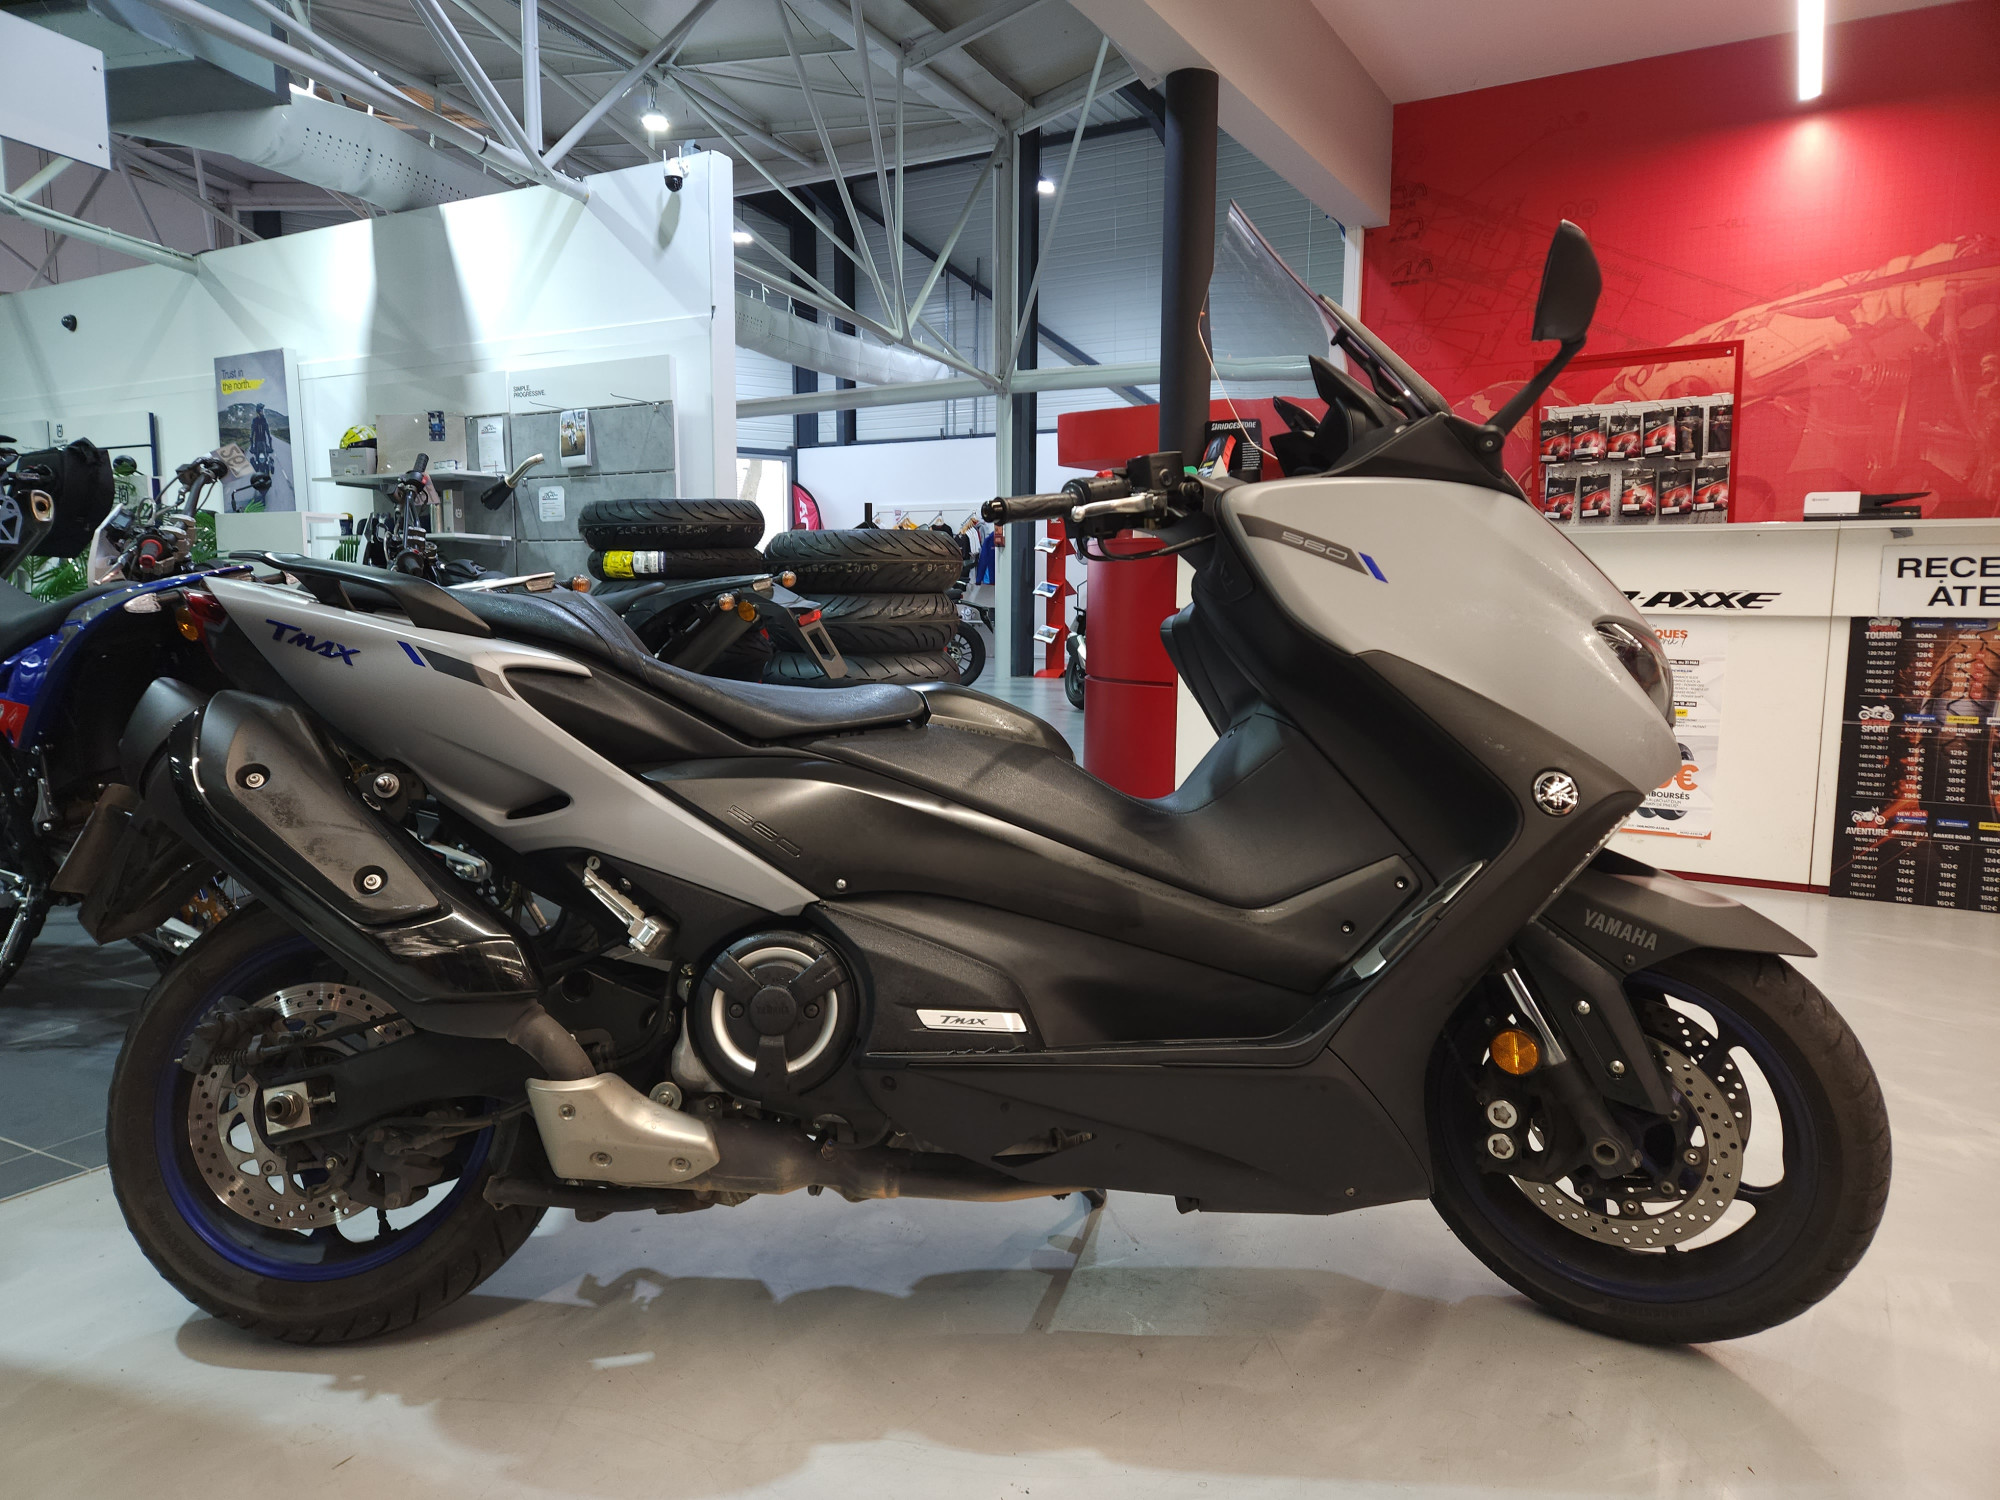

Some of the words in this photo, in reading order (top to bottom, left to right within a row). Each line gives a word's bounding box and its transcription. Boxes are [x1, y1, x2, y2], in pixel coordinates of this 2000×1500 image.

[222, 370, 236, 379] Trust
[238, 368, 244, 377] in
[222, 383, 232, 391] the
[1282, 530, 1348, 560] 560
[1897, 557, 2000, 578] RECE
[1927, 586, 2000, 606] ATE
[1861, 725, 1889, 733] SPORT
[1649, 791, 1690, 800] BOURSÉS
[1845, 827, 1889, 836] AVENTURE
[1584, 908, 1658, 951] YAMAHA
